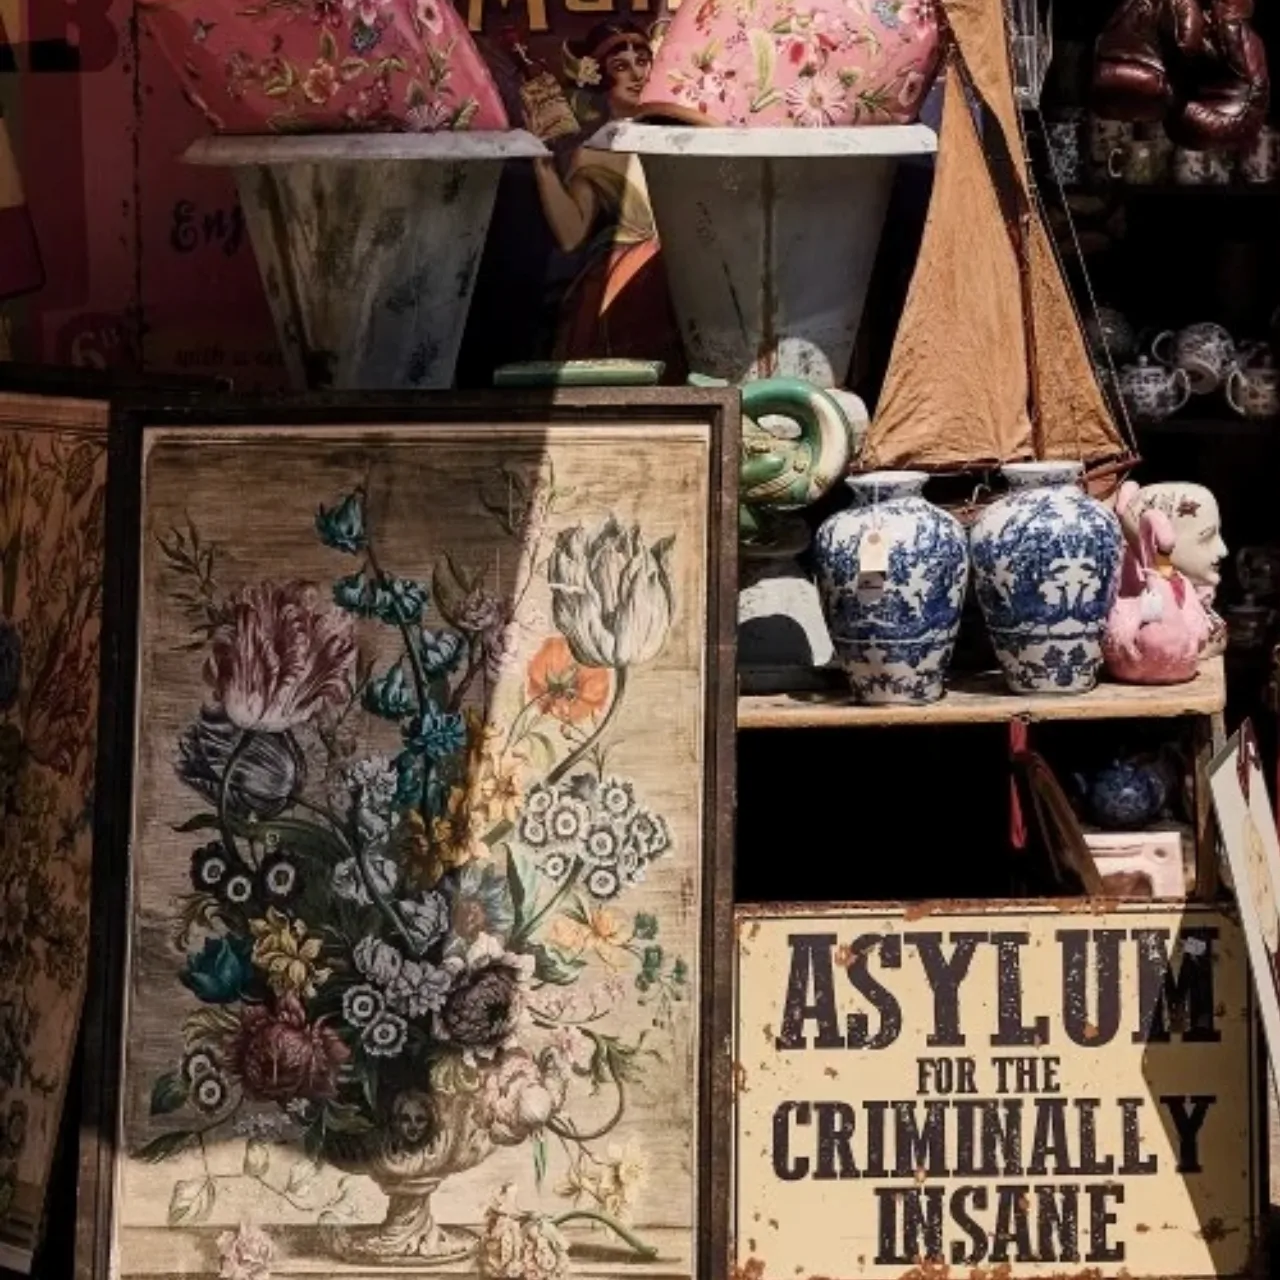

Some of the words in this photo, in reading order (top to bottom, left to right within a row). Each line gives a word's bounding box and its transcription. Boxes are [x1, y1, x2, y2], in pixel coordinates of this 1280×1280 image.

[776, 928, 1222, 1051] ASYLUM
[916, 1056, 978, 1095] FOR
[991, 1056, 1061, 1095] THE
[772, 1095, 1217, 1181] CRIMINALLY
[873, 1184, 1126, 1266] INSANE
